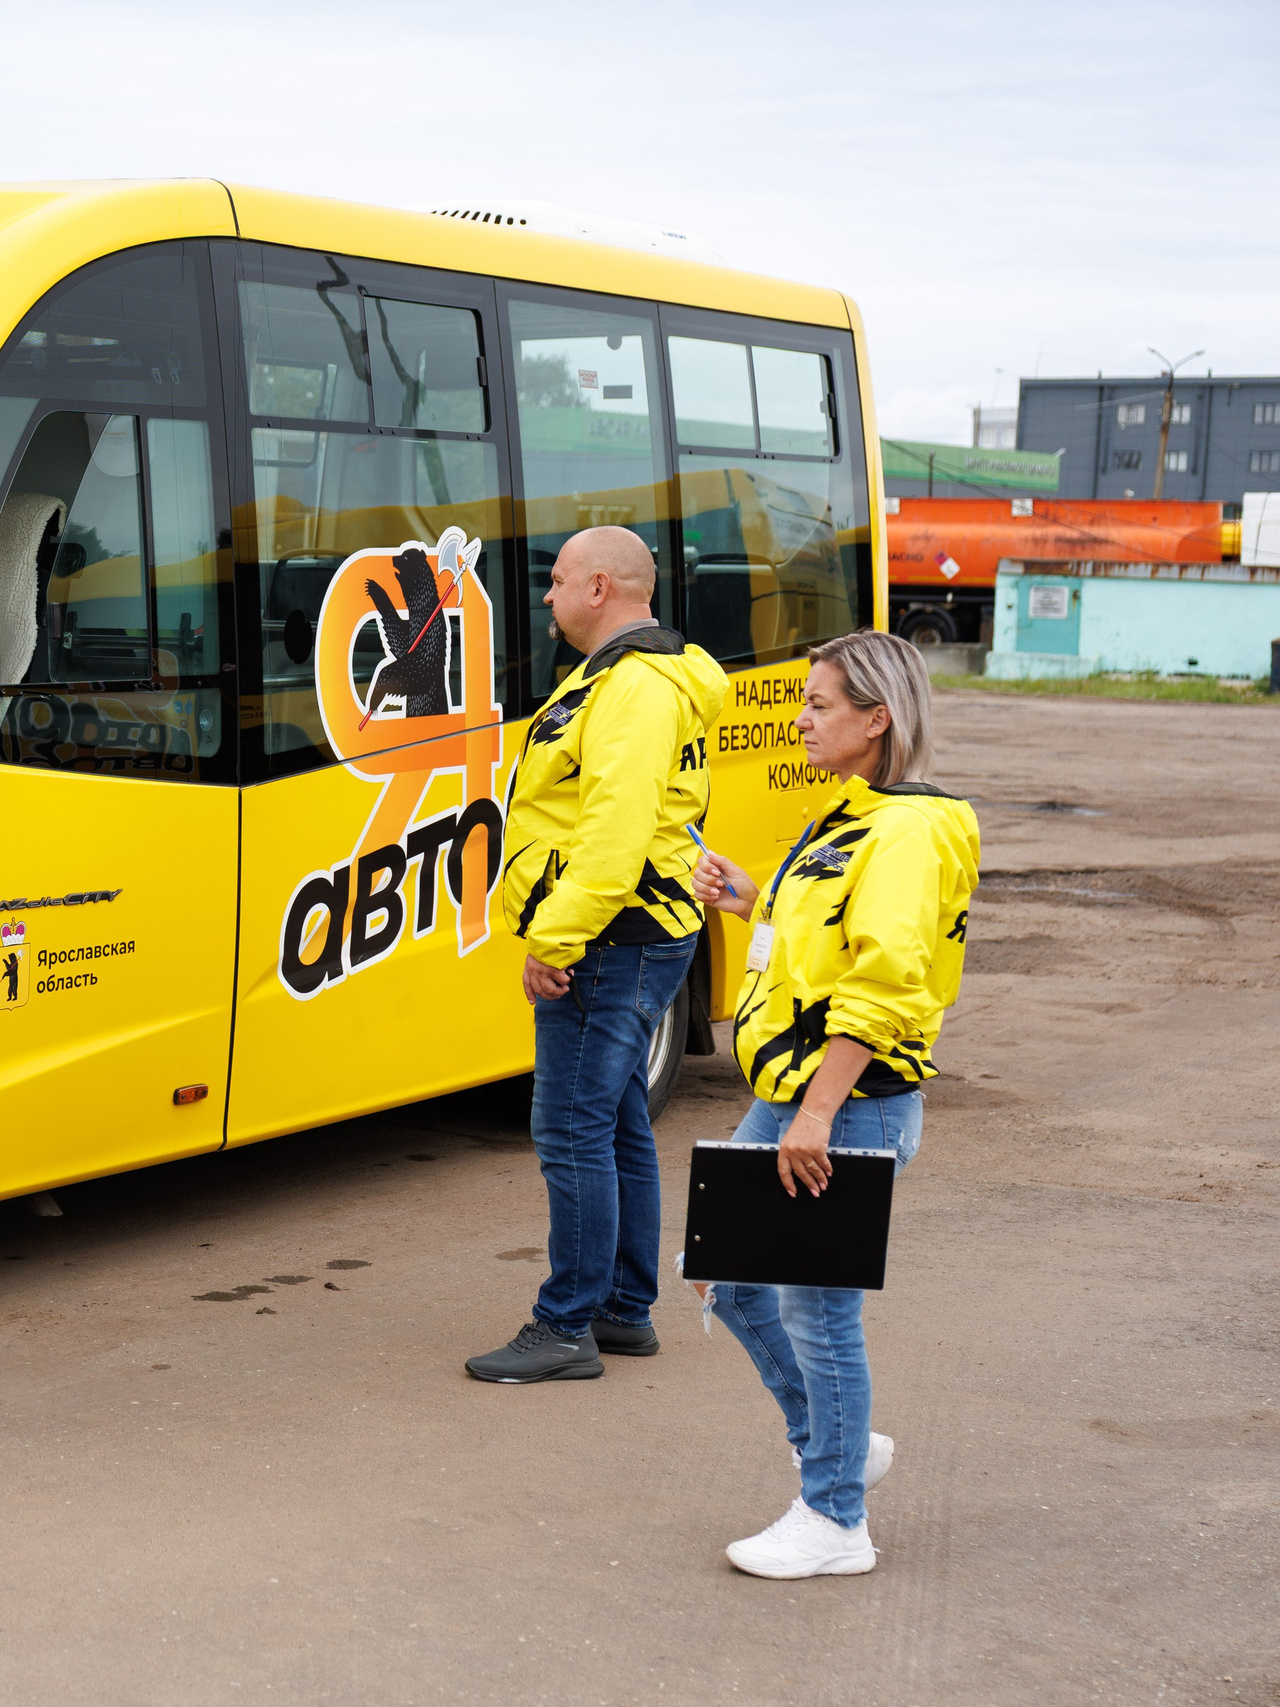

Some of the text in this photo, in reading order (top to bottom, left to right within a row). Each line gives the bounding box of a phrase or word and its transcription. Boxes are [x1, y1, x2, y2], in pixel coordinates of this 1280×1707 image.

[281, 797, 504, 994] авто
[37, 940, 135, 970] Ярославская
[36, 972, 98, 994] область
